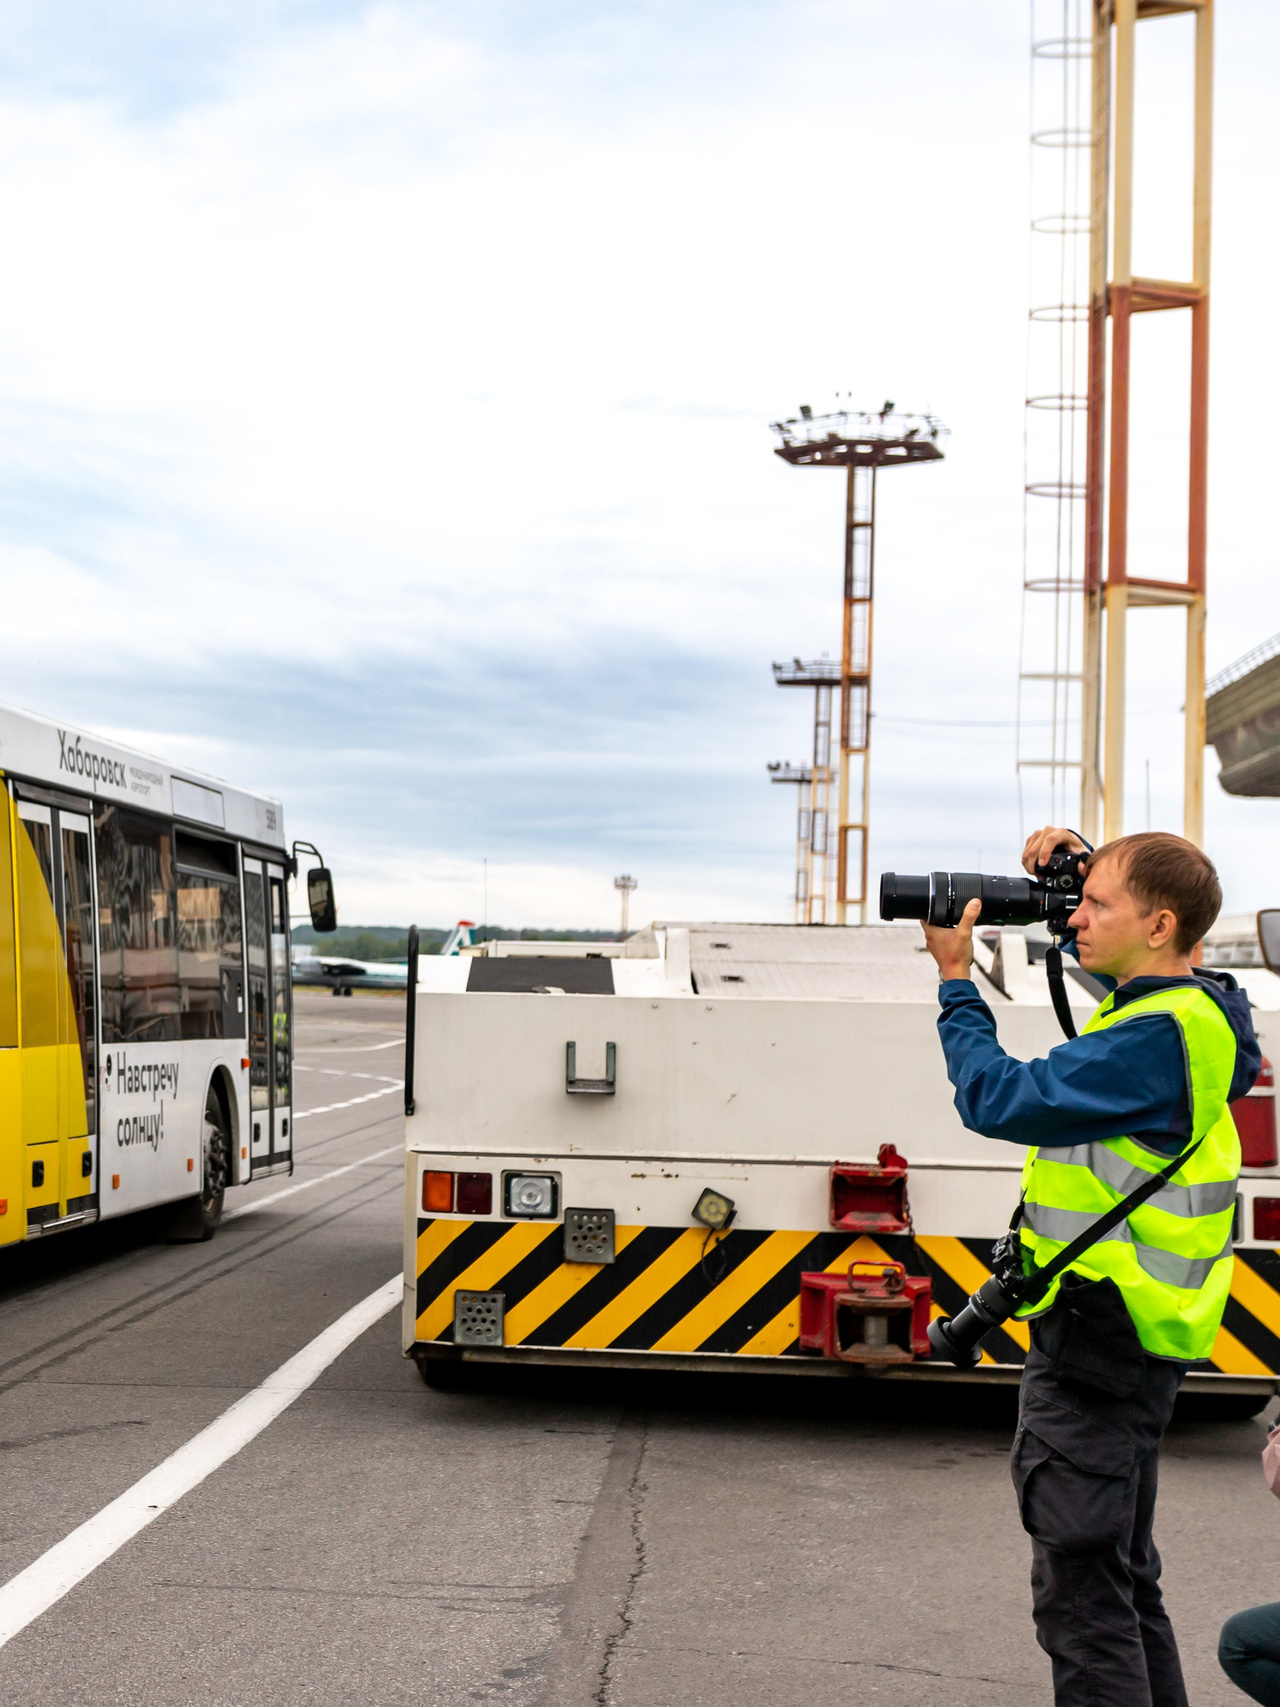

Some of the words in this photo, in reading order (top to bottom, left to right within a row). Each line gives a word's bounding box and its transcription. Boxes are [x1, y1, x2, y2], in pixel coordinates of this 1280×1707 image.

[57, 728, 127, 793] Хабаровск
[116, 1051, 179, 1103] Навстречу
[116, 1099, 164, 1152] солнцу!
